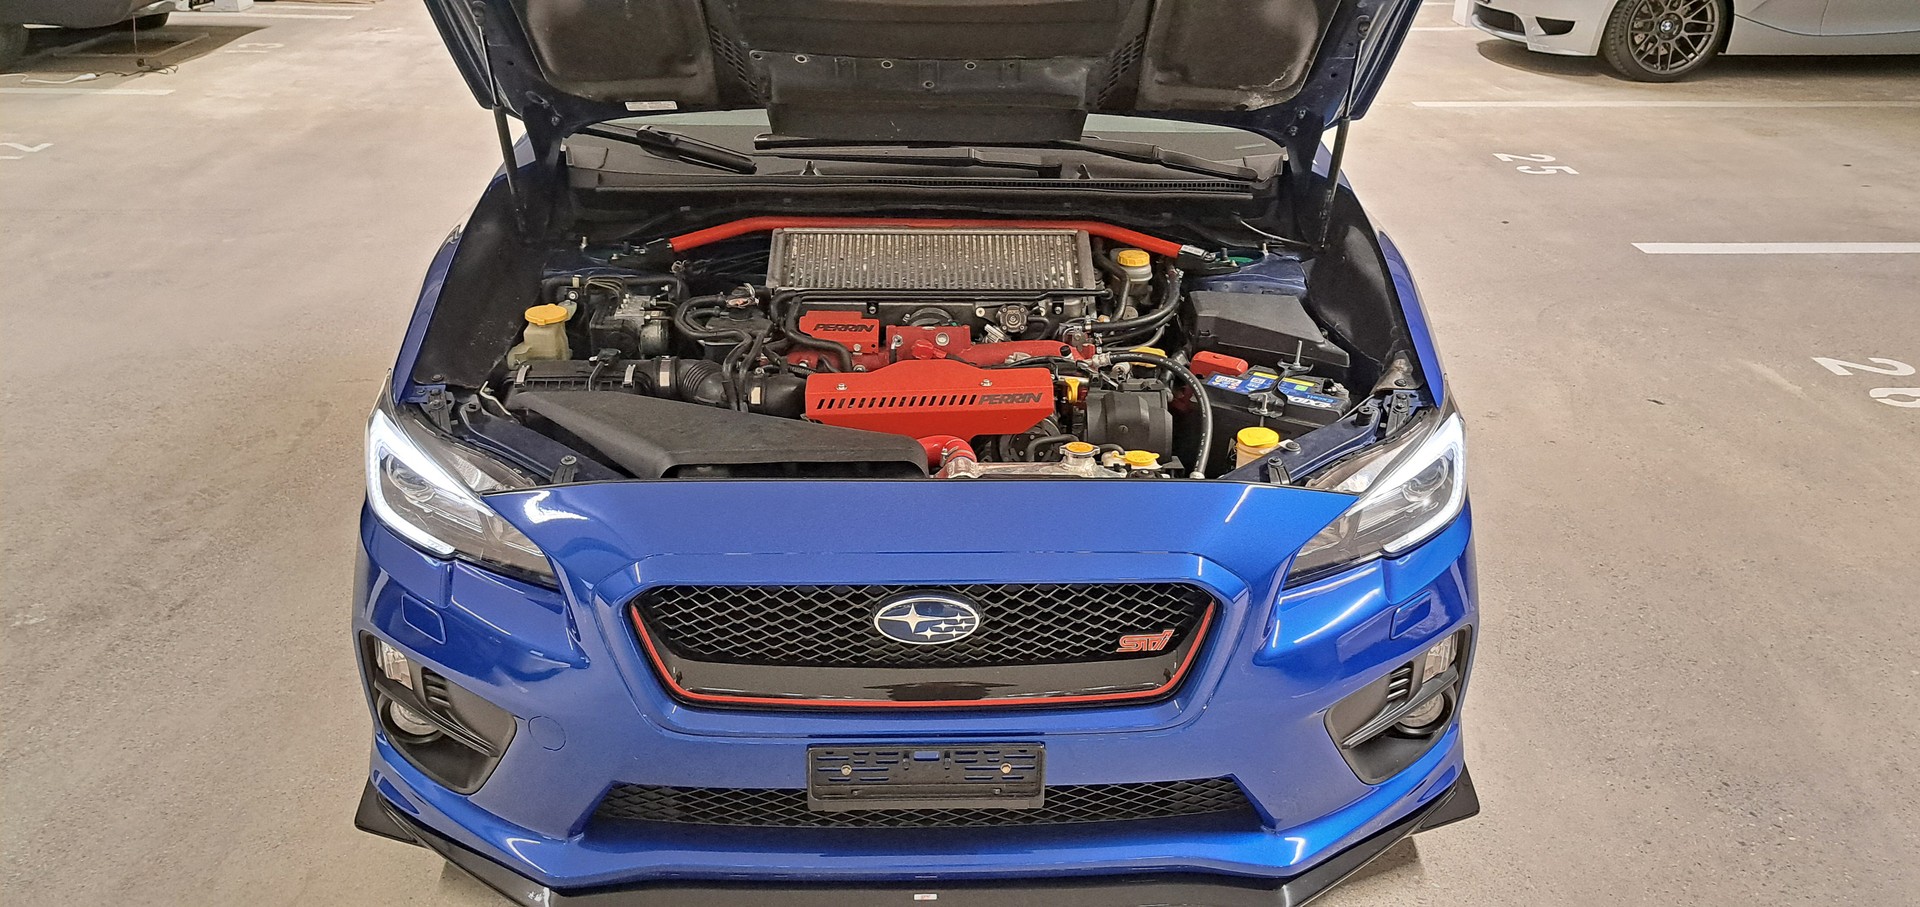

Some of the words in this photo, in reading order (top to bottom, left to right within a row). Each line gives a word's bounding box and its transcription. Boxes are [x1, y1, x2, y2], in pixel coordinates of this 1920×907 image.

[1492, 153, 1580, 175] 25
[813, 323, 875, 333] PERRIN
[979, 392, 1044, 406] PERRIN
